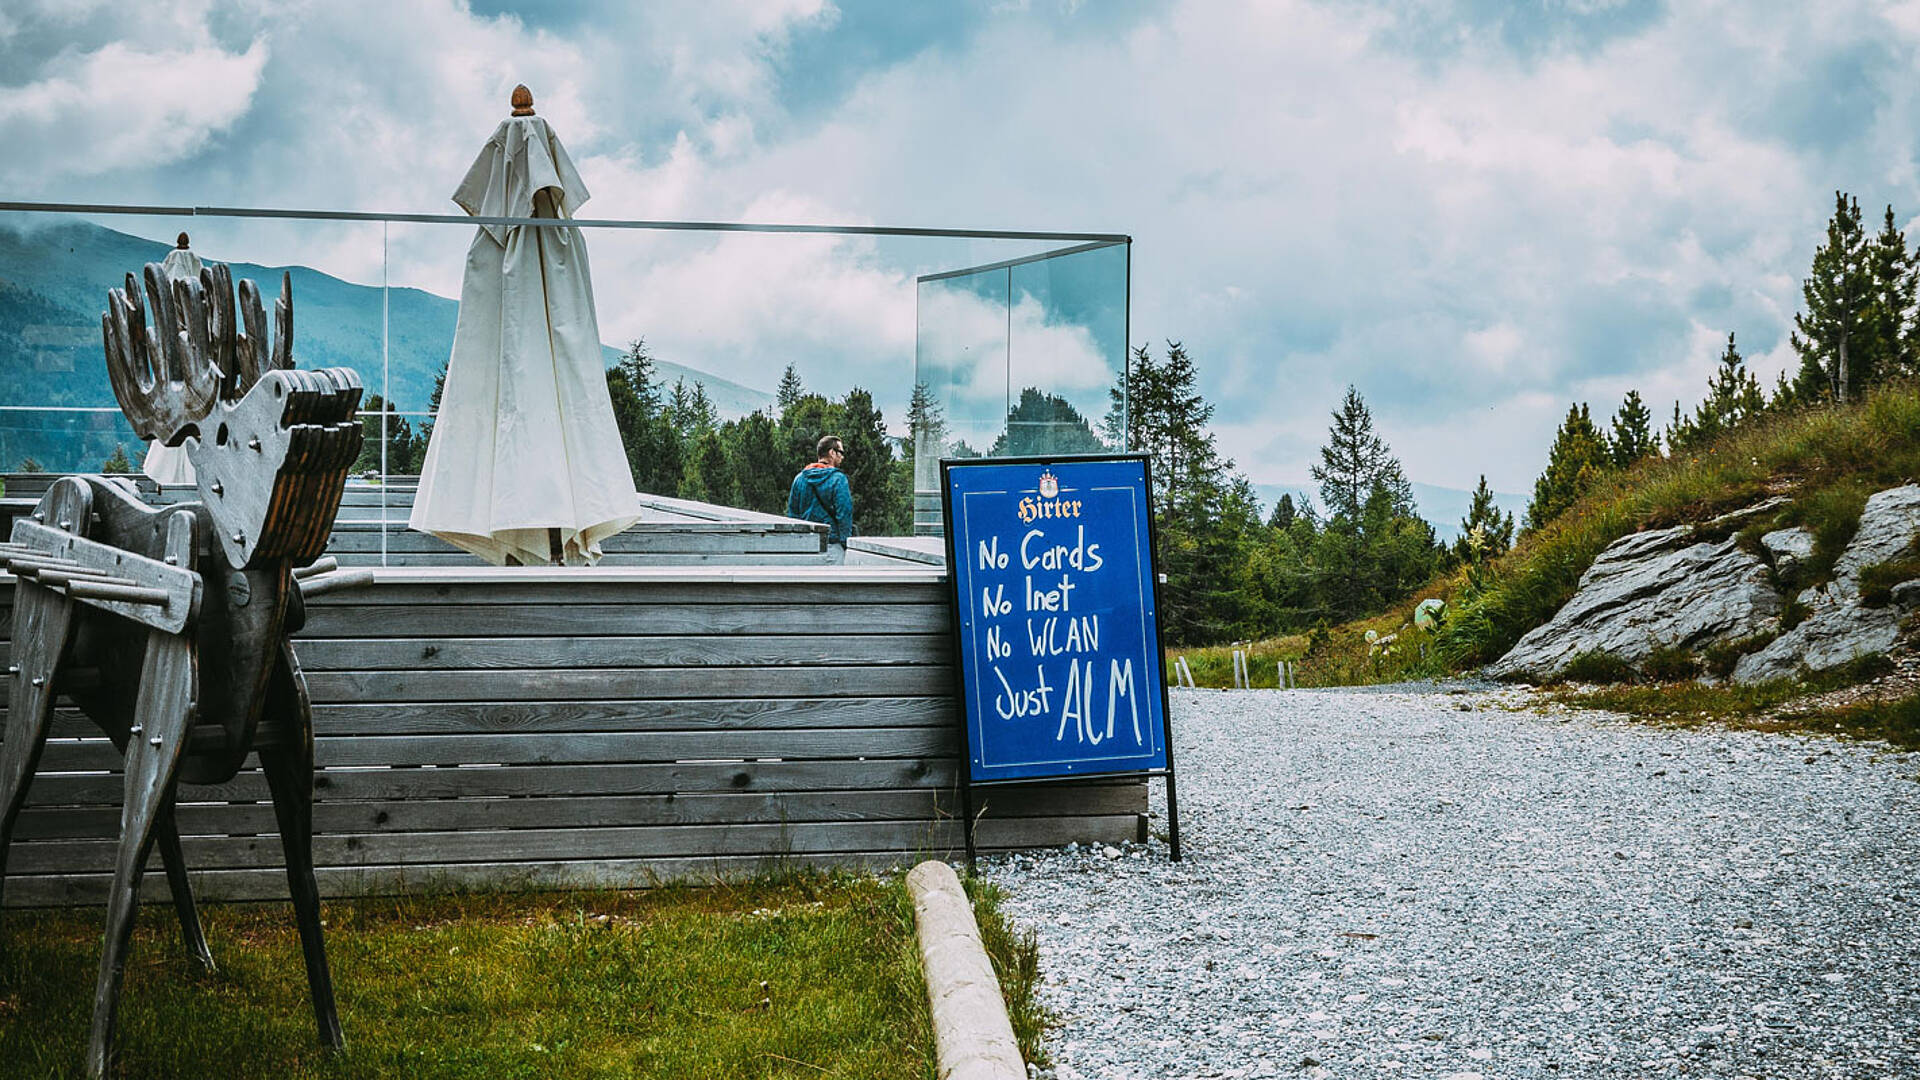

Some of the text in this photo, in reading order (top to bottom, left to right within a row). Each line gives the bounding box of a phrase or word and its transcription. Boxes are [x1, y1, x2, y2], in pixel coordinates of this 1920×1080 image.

[1018, 496, 1082, 524] Hirter
[979, 525, 1104, 572] No Cards
[983, 574, 1075, 618] No Inet
[987, 615, 1099, 662] No WLAN
[994, 658, 1142, 746] Just ALM
